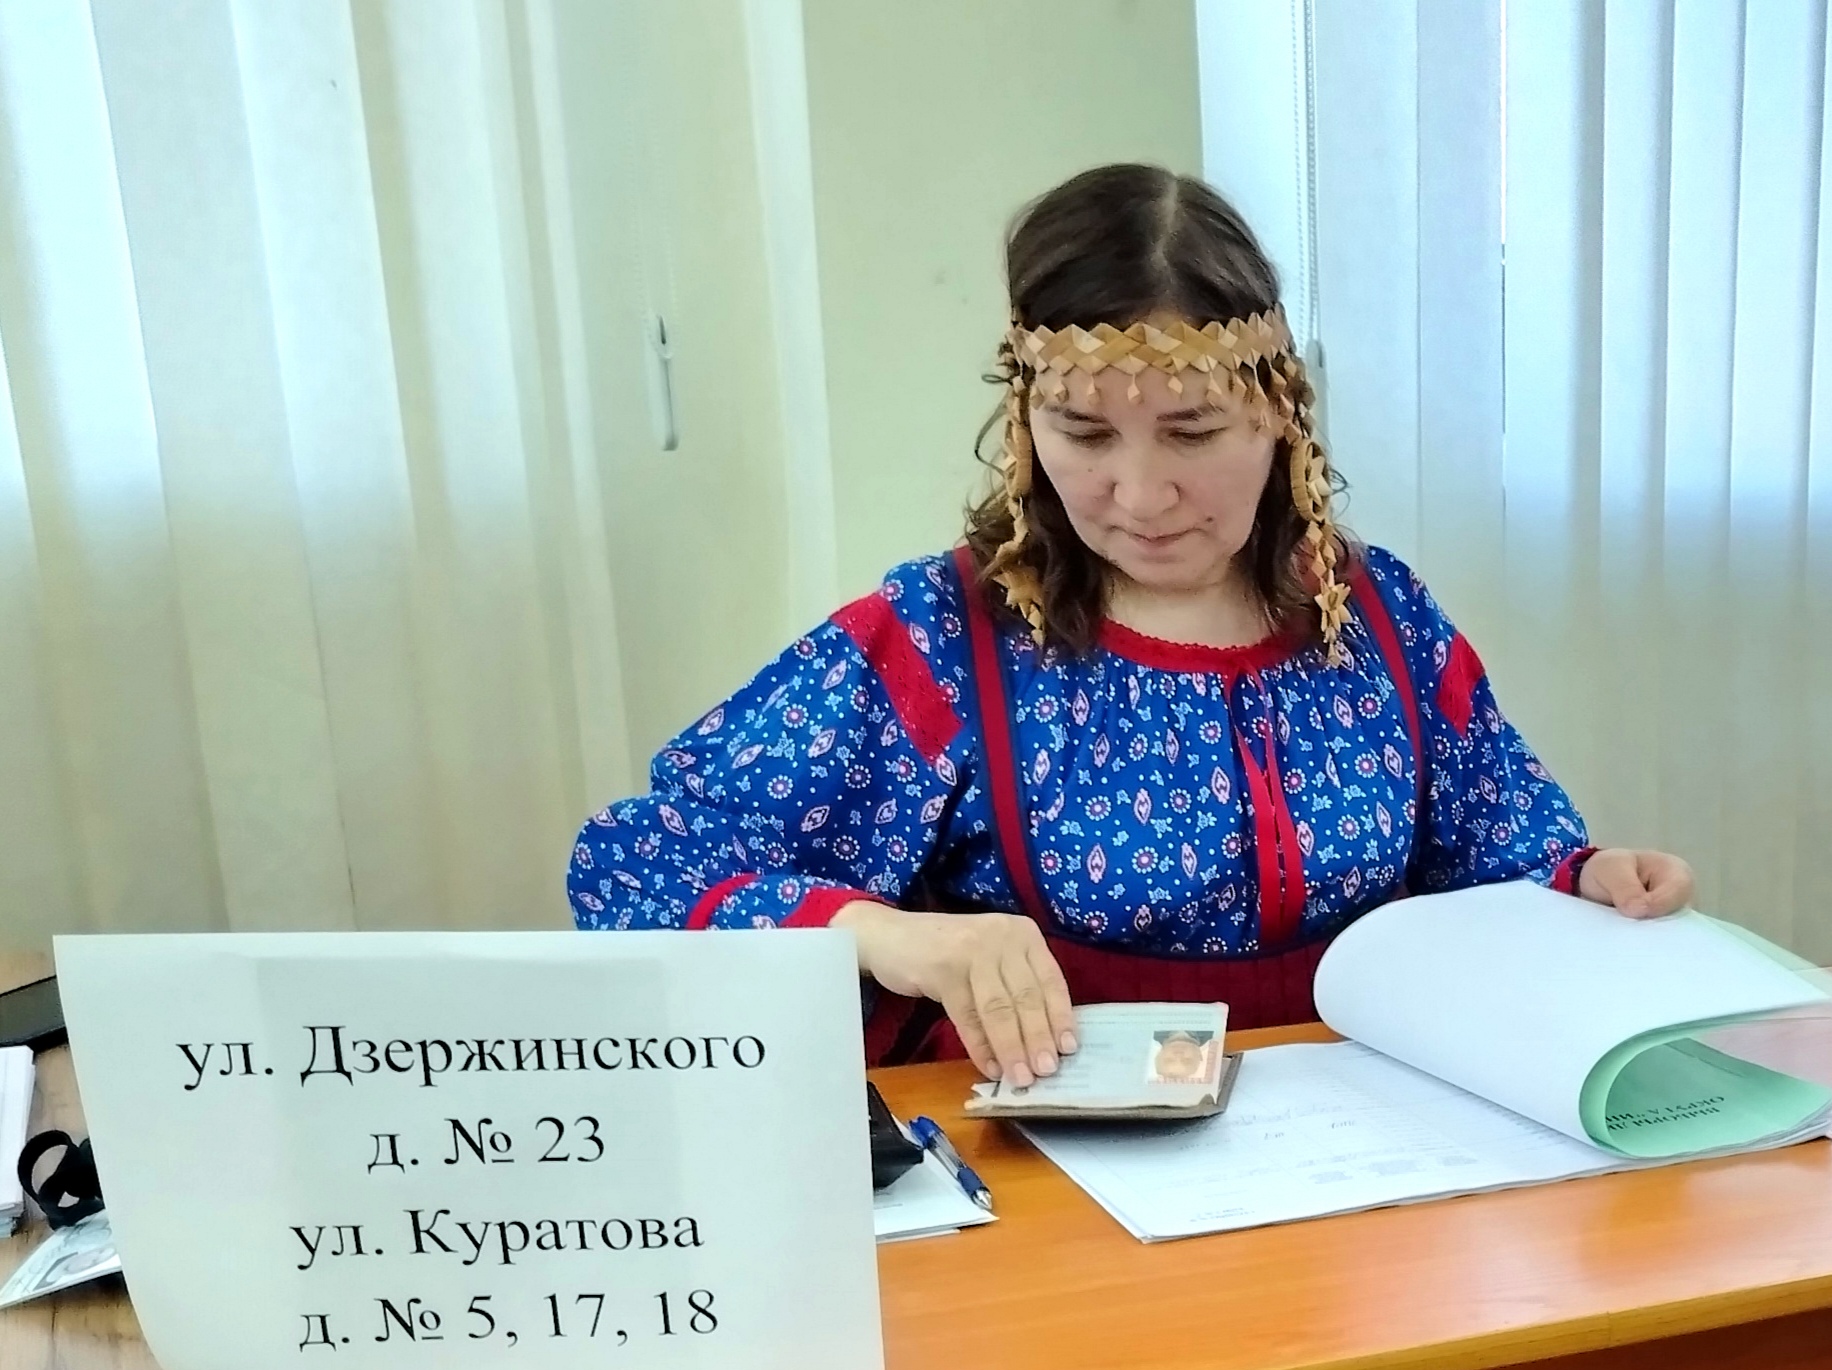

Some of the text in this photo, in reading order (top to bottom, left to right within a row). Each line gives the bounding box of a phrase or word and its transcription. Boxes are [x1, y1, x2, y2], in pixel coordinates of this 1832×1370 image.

[174, 1024, 767, 1091] ул. Дзержинского
[367, 1115, 606, 1174] д. № 23
[289, 1208, 705, 1271] ул. Куратова
[299, 1289, 718, 1352] д. № 5, 17, 18
